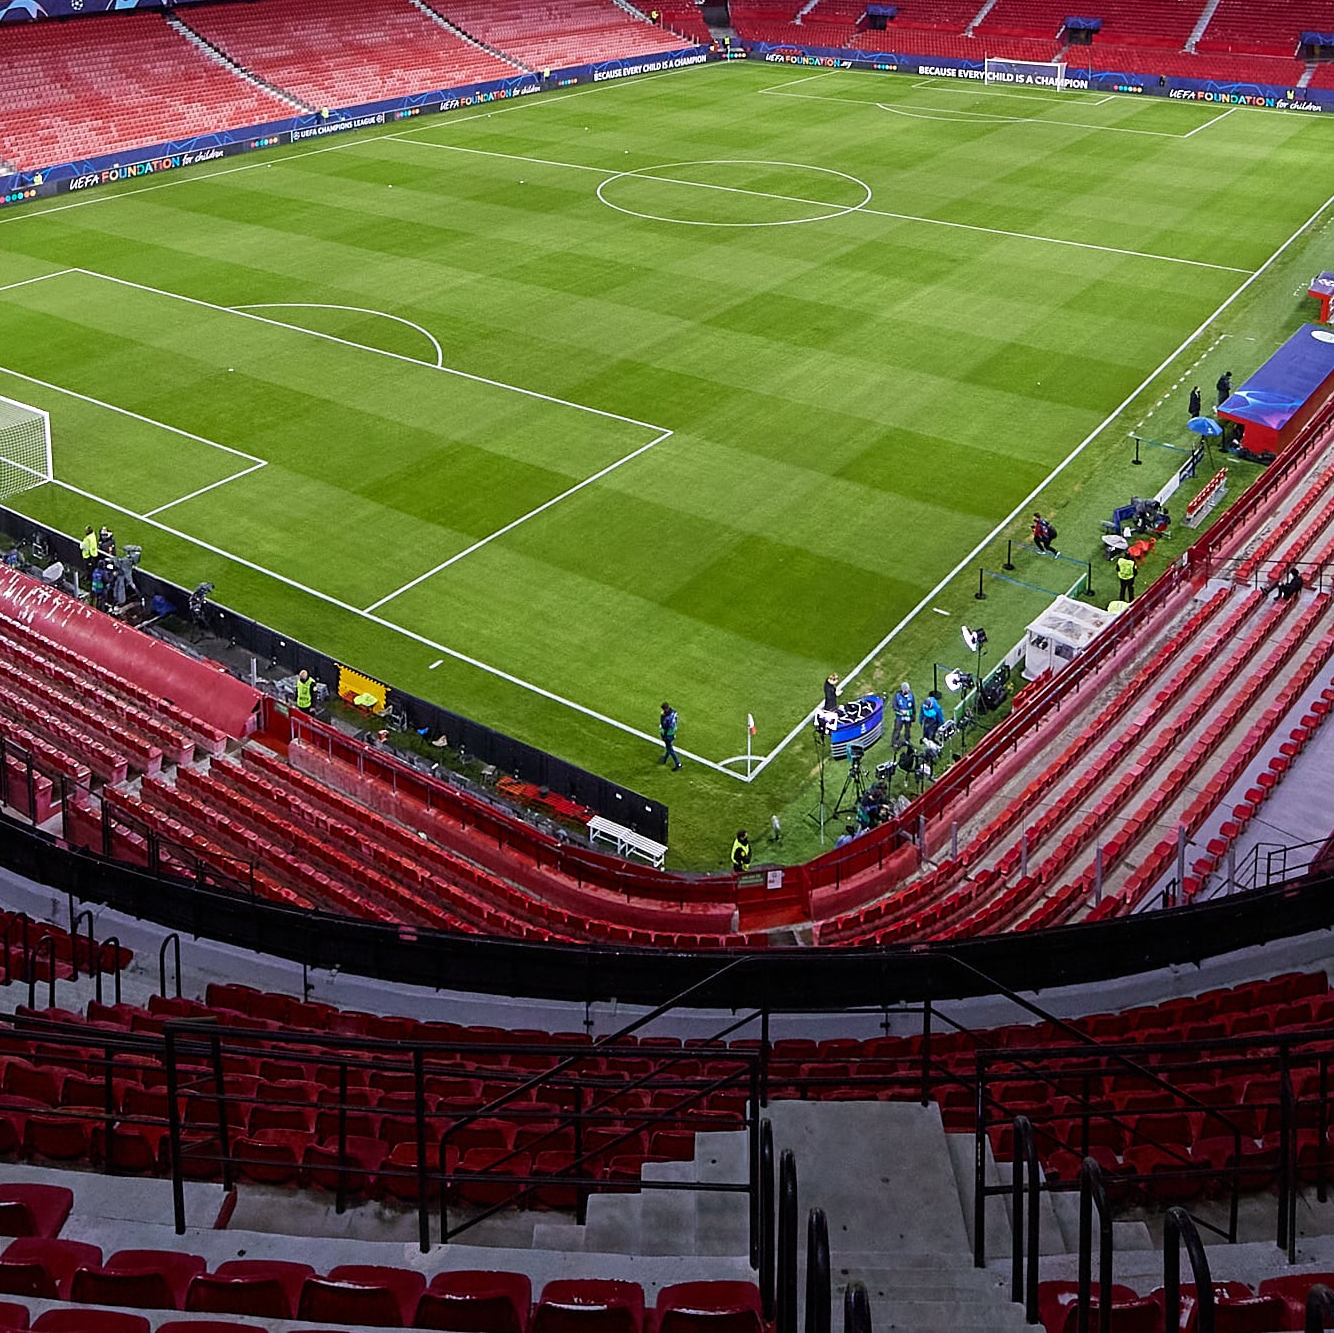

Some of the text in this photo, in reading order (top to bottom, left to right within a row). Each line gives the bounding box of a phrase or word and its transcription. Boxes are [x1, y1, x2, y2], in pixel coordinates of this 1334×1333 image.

[593, 68, 623, 82] BECAUSE
[623, 65, 643, 77] EVERY
[643, 62, 662, 73] CHILD
[674, 55, 707, 68] CHAMPION
[765, 53, 785, 63] UEFA
[918, 66, 1089, 90] BECAUSE EVERY CHILD IS A CHAMPION
[439, 100, 460, 111] UEFA
[512, 87, 521, 97] for
[521, 84, 541, 95] children
[1169, 89, 1196, 100] UEFA
[1276, 98, 1289, 110] for
[1289, 100, 1323, 112] children
[300, 117, 376, 139] UEFA CHAMPIONS LEAGUE
[69, 174, 100, 191] UEFA
[182, 155, 194, 166] for
[194, 148, 224, 163] children
